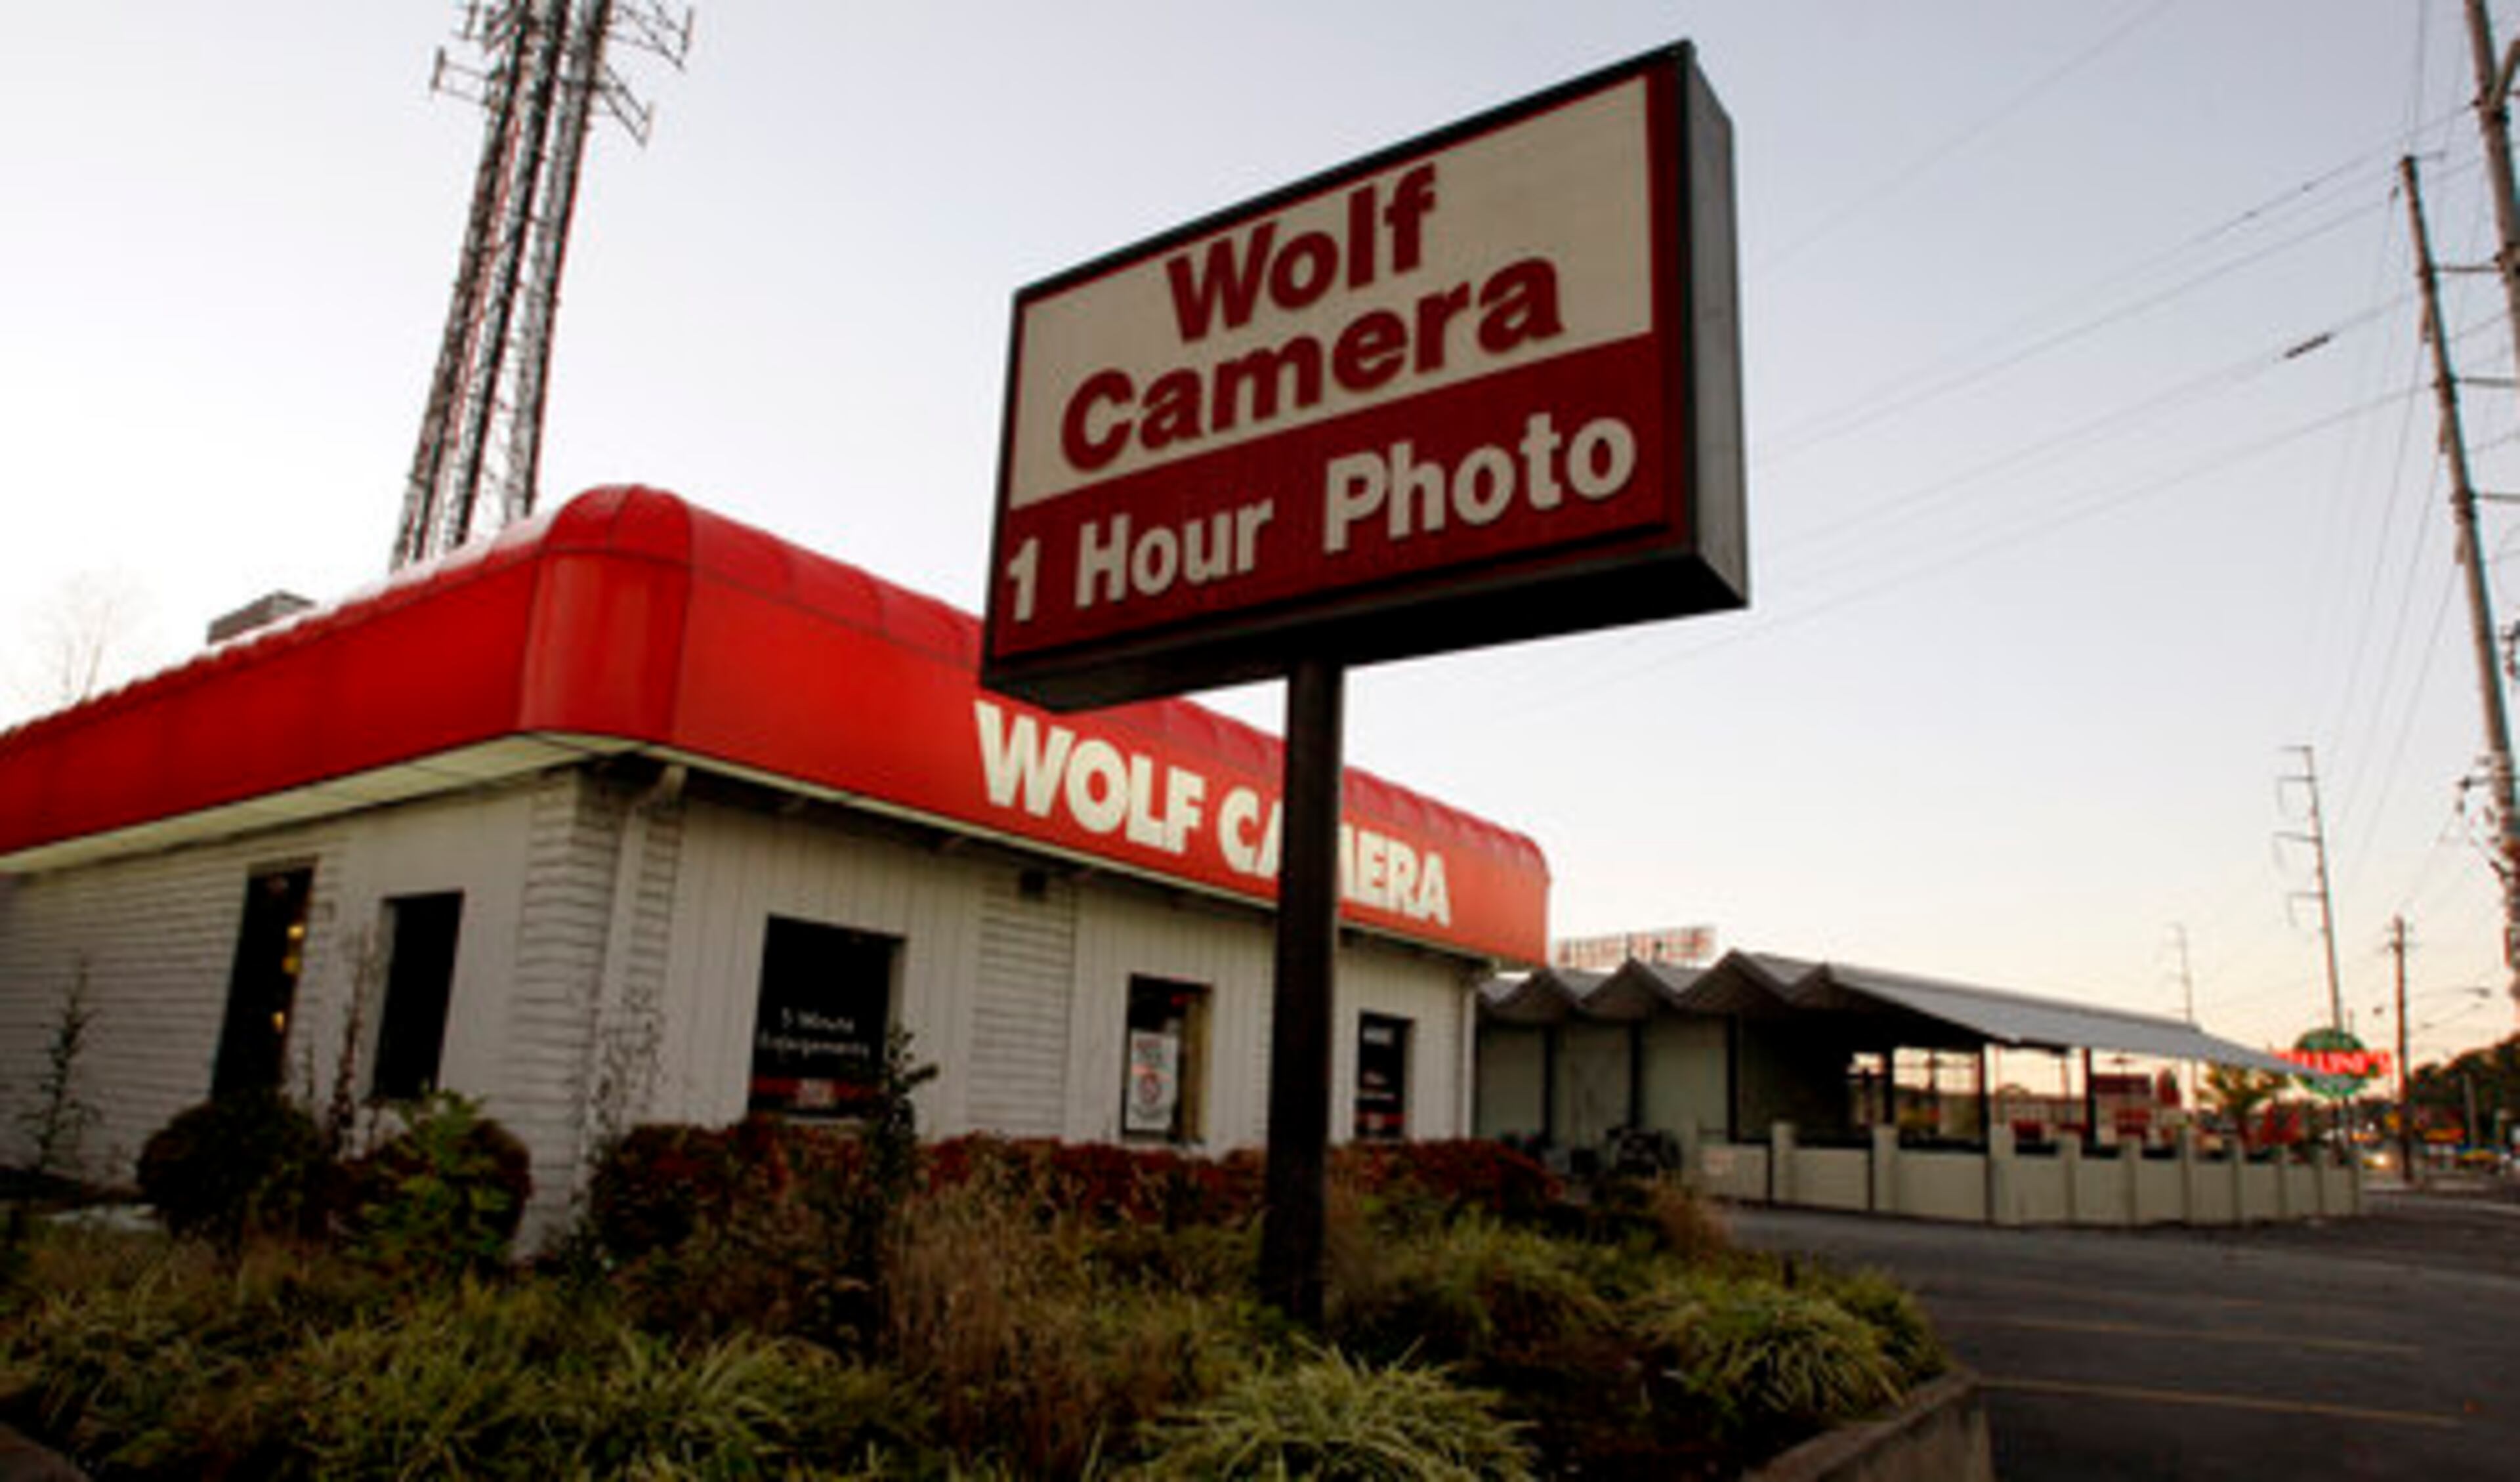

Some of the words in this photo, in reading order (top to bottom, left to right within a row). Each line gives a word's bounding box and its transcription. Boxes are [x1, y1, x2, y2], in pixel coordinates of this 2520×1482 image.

[1165, 161, 1437, 344] Wolf
[1060, 257, 1564, 473] Camera
[1007, 536, 1040, 622] 1
[1074, 498, 1274, 609] Hour
[1322, 412, 1638, 555] Photo
[974, 698, 1207, 855] WOLF
[1217, 787, 1450, 927] CAERA
